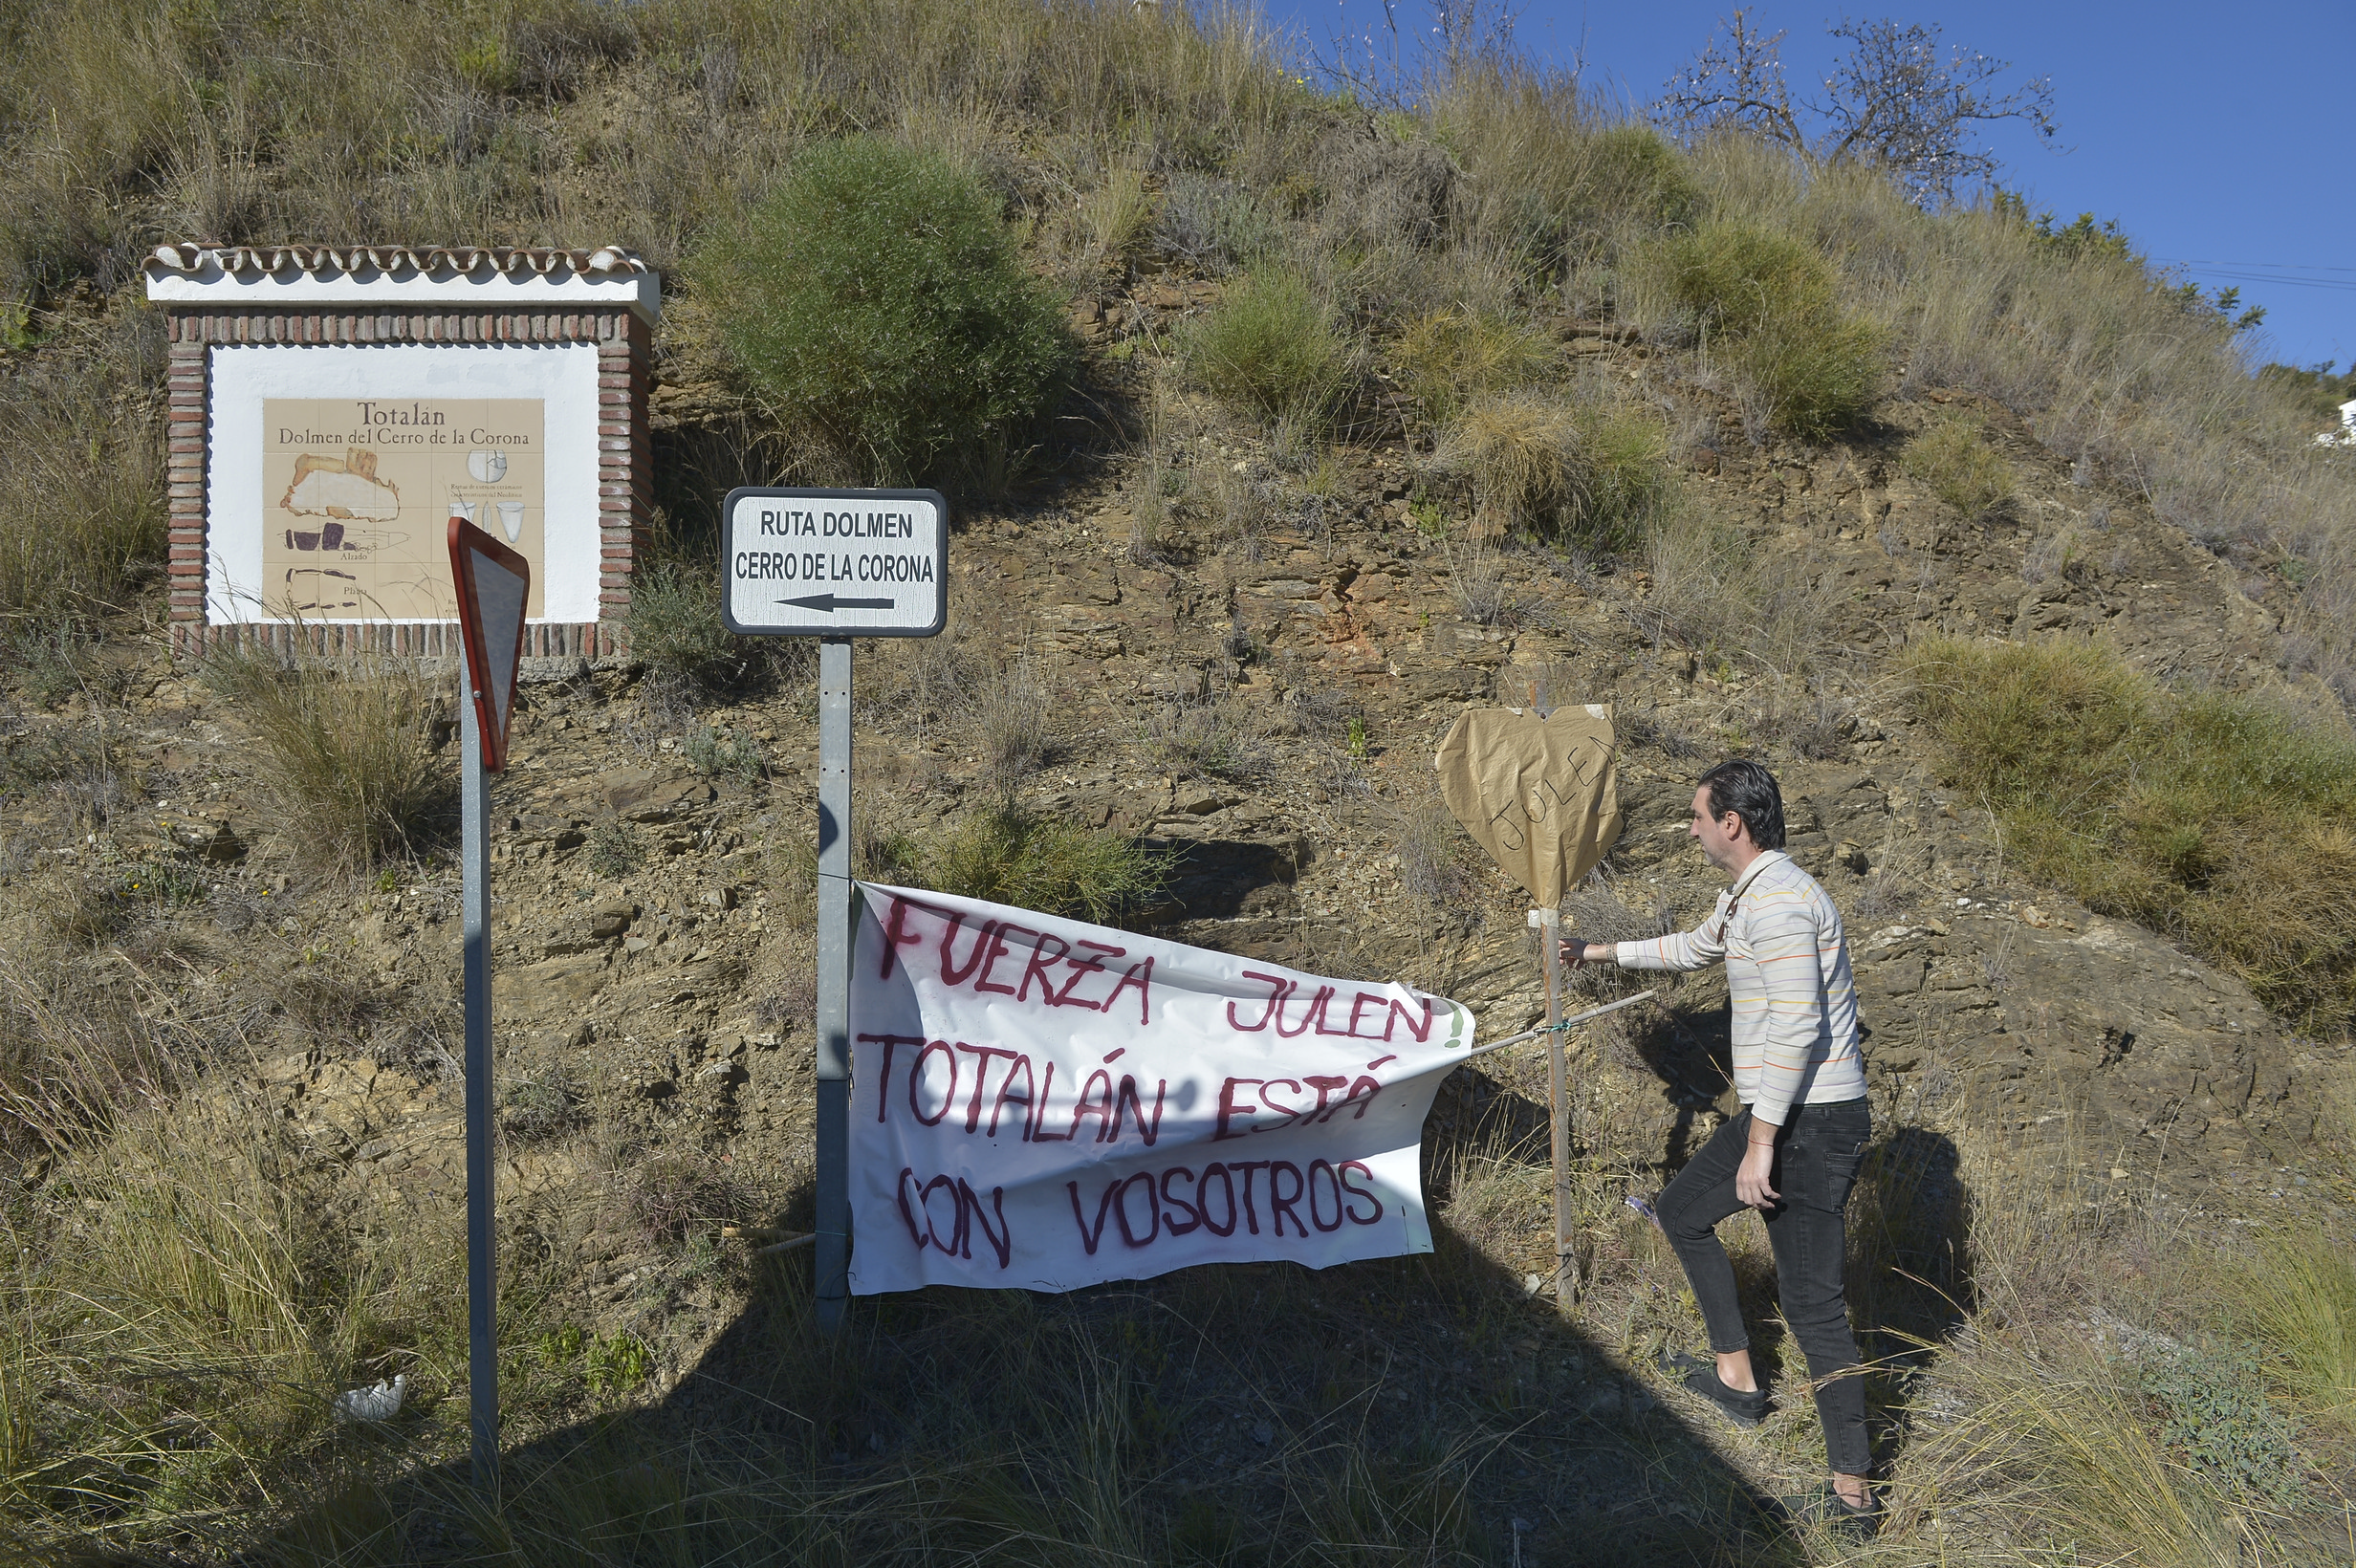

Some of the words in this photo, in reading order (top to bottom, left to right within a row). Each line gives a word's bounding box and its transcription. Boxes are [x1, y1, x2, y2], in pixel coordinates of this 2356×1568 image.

[279, 428, 342, 444] Dolmen
[348, 428, 371, 444] del
[377, 428, 424, 444] Cerro
[430, 428, 447, 444] de
[452, 428, 465, 444] la
[469, 428, 530, 445] Corona
[358, 402, 446, 425] Totalán
[761, 511, 817, 536] RUTA
[823, 512, 913, 538] DOLMEN
[736, 552, 797, 579] CERRO
[802, 553, 825, 580] DE
[831, 554, 853, 581] LA
[859, 555, 934, 582] CORONA
[1489, 713, 1616, 851] JULEN
[881, 895, 1154, 1026] FUERZA
[857, 1033, 1167, 1146] TOTALÁN
[1211, 1055, 1397, 1143] ESTÁ
[898, 1167, 1011, 1270] CON
[1066, 1158, 1384, 1254] VOSOTROS
